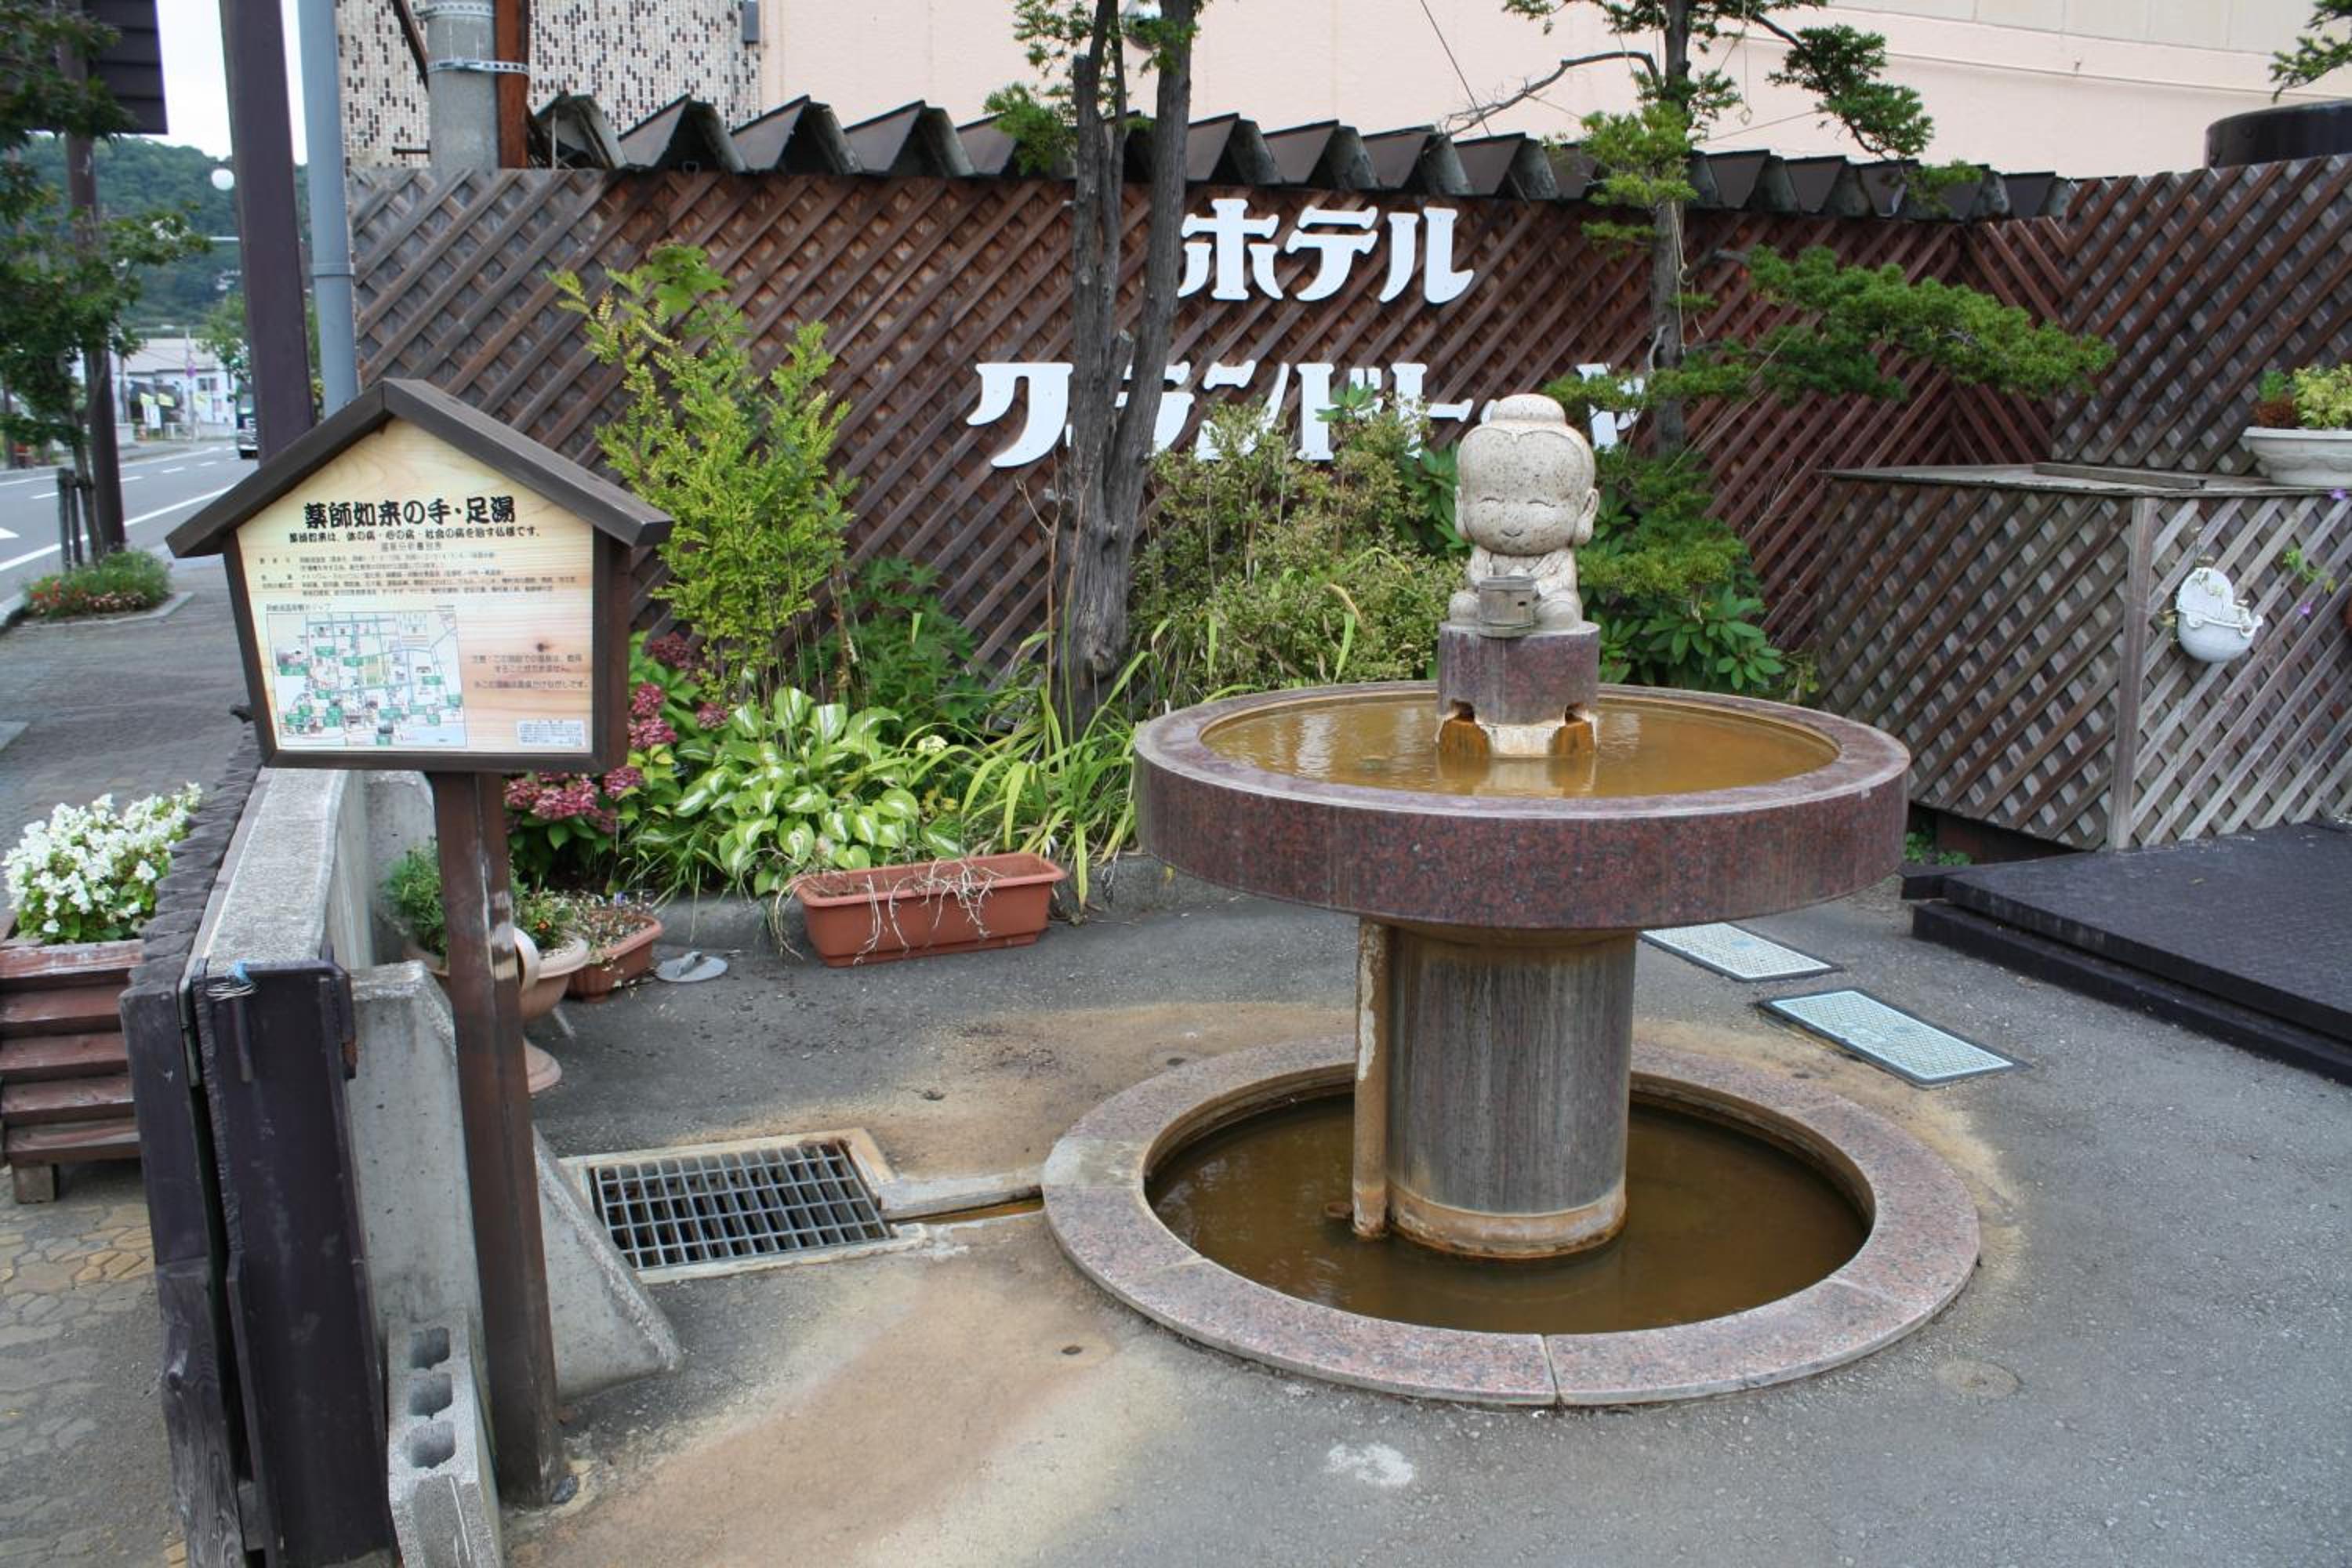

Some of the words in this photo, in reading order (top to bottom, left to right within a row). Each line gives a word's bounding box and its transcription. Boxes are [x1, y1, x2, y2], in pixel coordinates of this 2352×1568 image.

[1178, 198, 1474, 304] ホテル
[303, 496, 515, 529] 薬師如来の手・足湯
